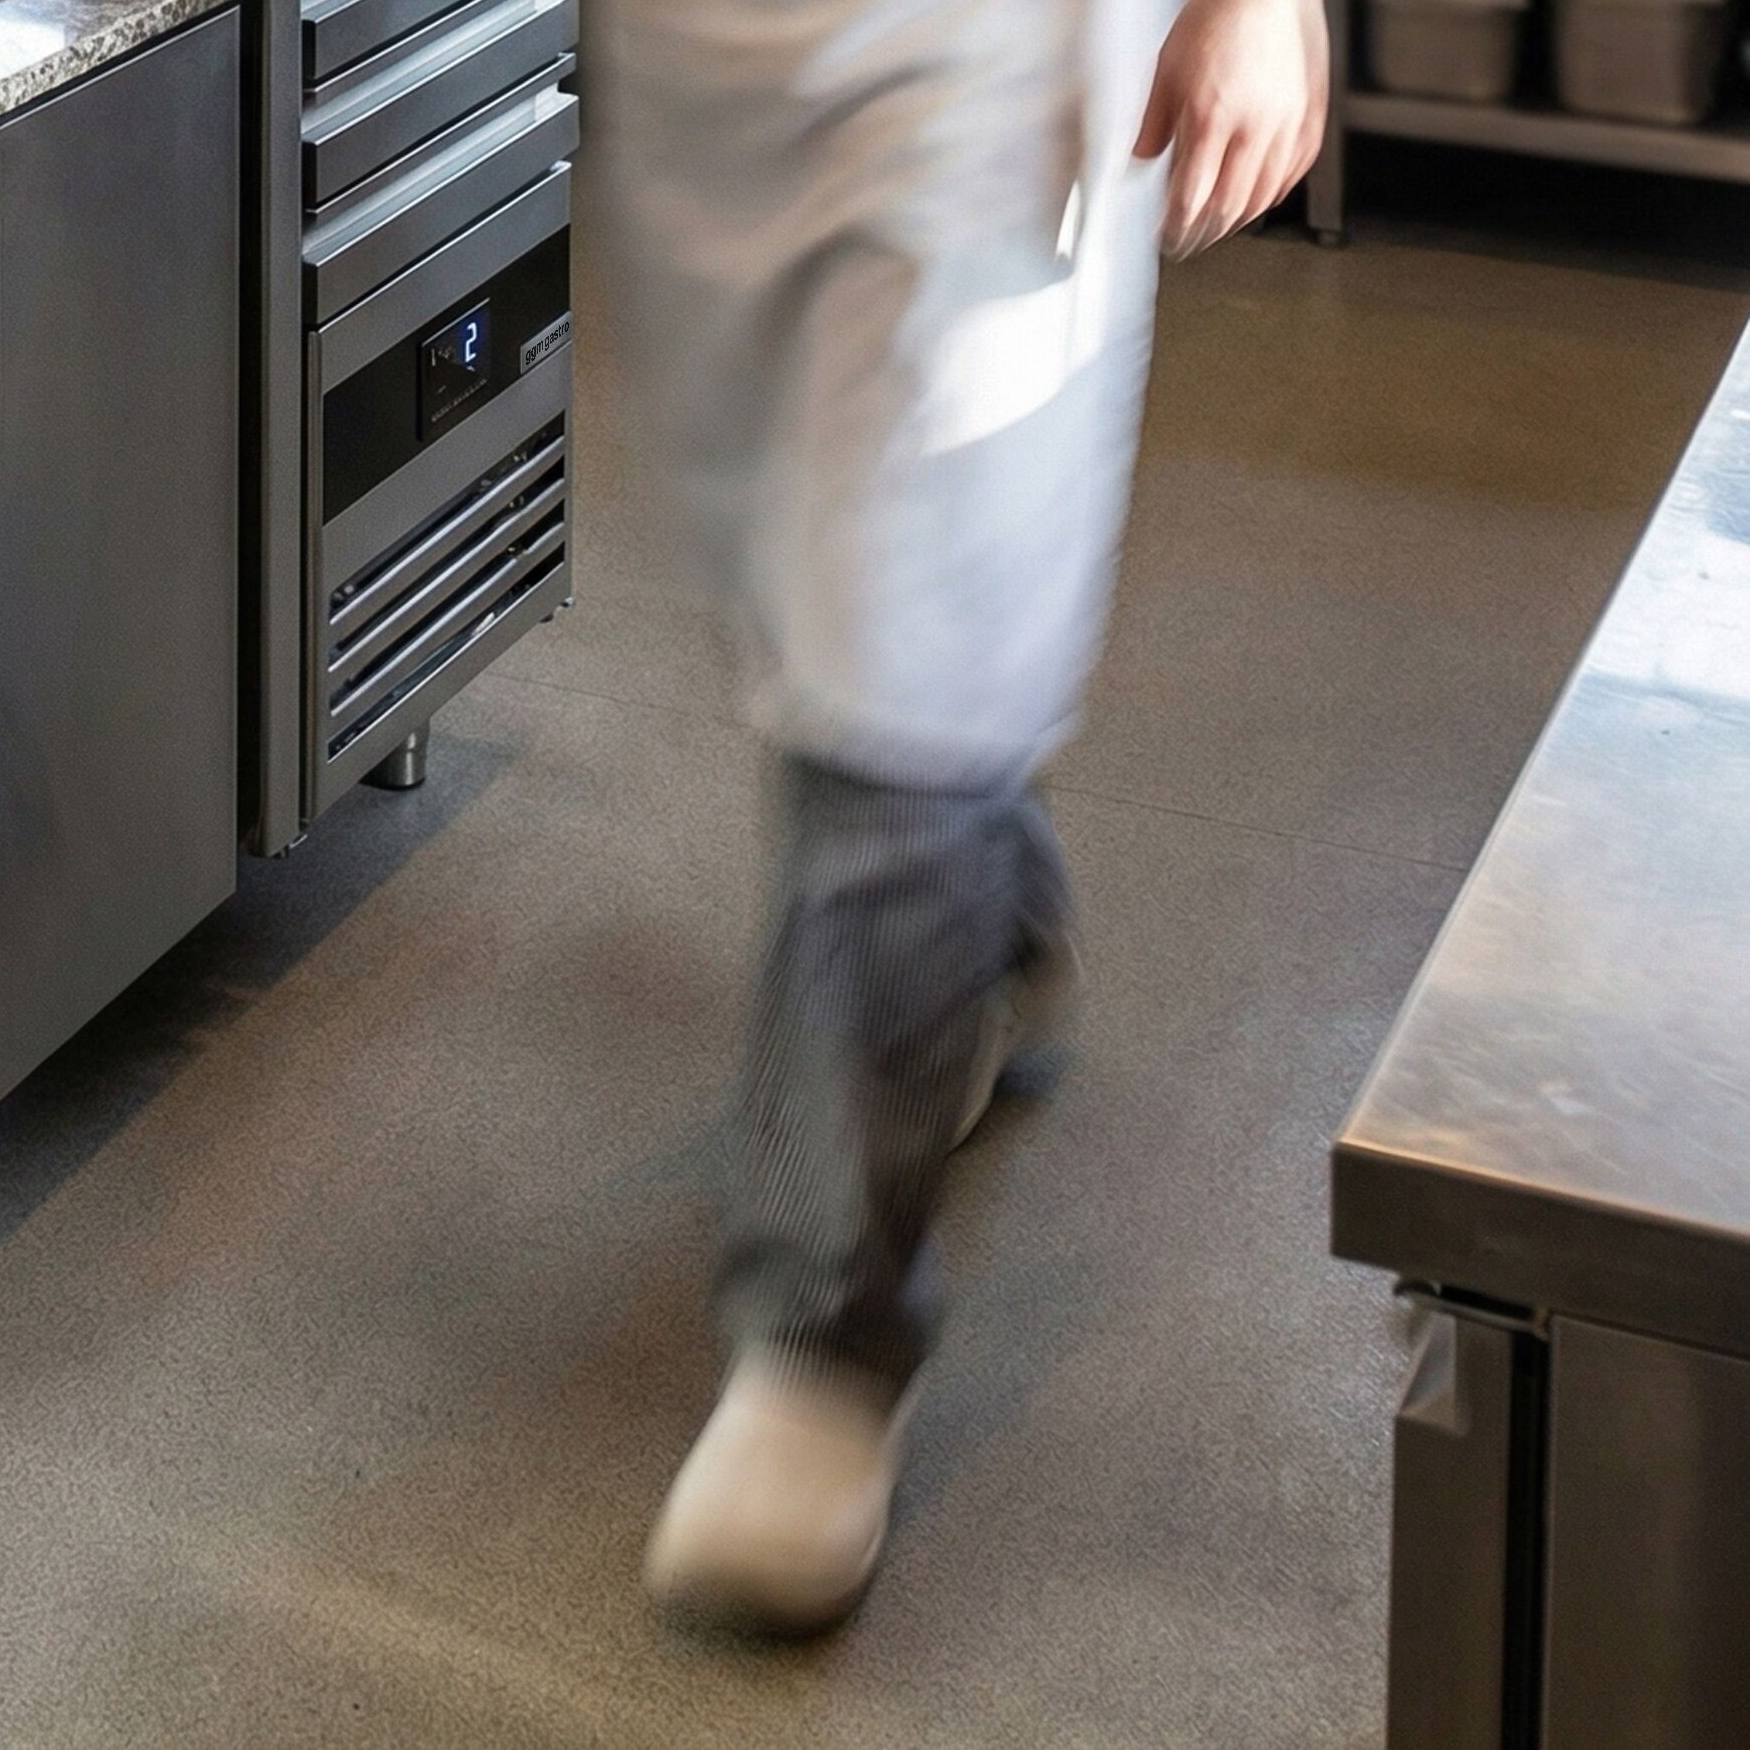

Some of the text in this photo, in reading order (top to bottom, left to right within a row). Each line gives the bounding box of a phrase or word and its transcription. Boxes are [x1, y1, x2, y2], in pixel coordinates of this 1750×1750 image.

[465, 322, 478, 362] 2
[525, 321, 570, 365] ggm gastro
